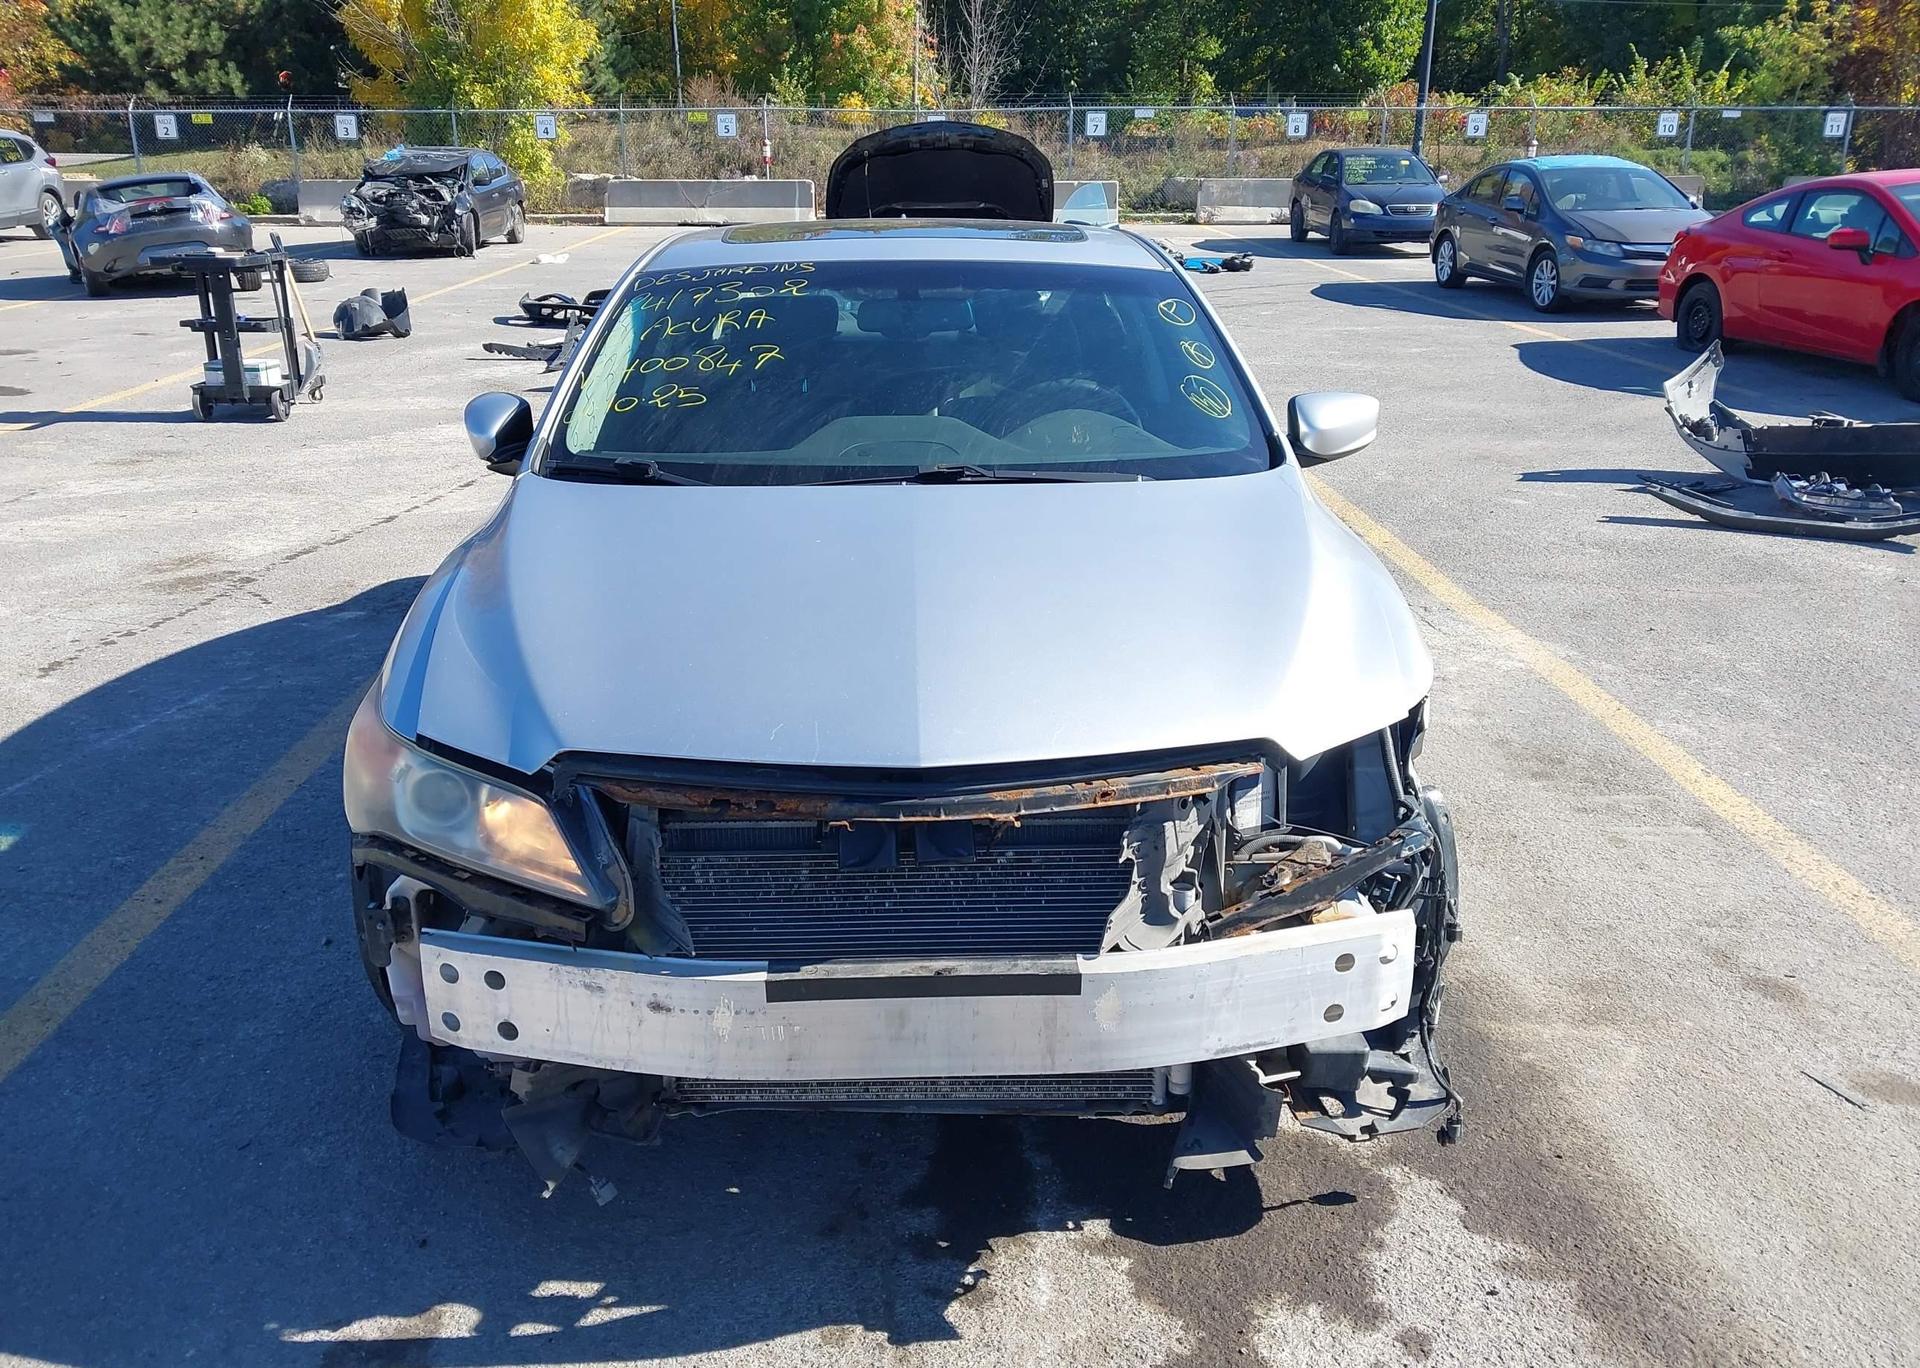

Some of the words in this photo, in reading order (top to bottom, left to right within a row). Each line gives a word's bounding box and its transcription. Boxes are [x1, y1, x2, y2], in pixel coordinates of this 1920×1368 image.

[164, 127, 170, 135] 2
[343, 127, 350, 136] 3
[542, 127, 549, 136] 4
[724, 126, 730, 134] 5
[1092, 124, 1098, 133] 7
[1294, 125, 1300, 133] 8
[1473, 126, 1479, 134] 9
[1662, 124, 1674, 132] 10
[1829, 124, 1840, 133] 11
[633, 262, 815, 291] DESJARDINS
[641, 308, 776, 340] ACURA
